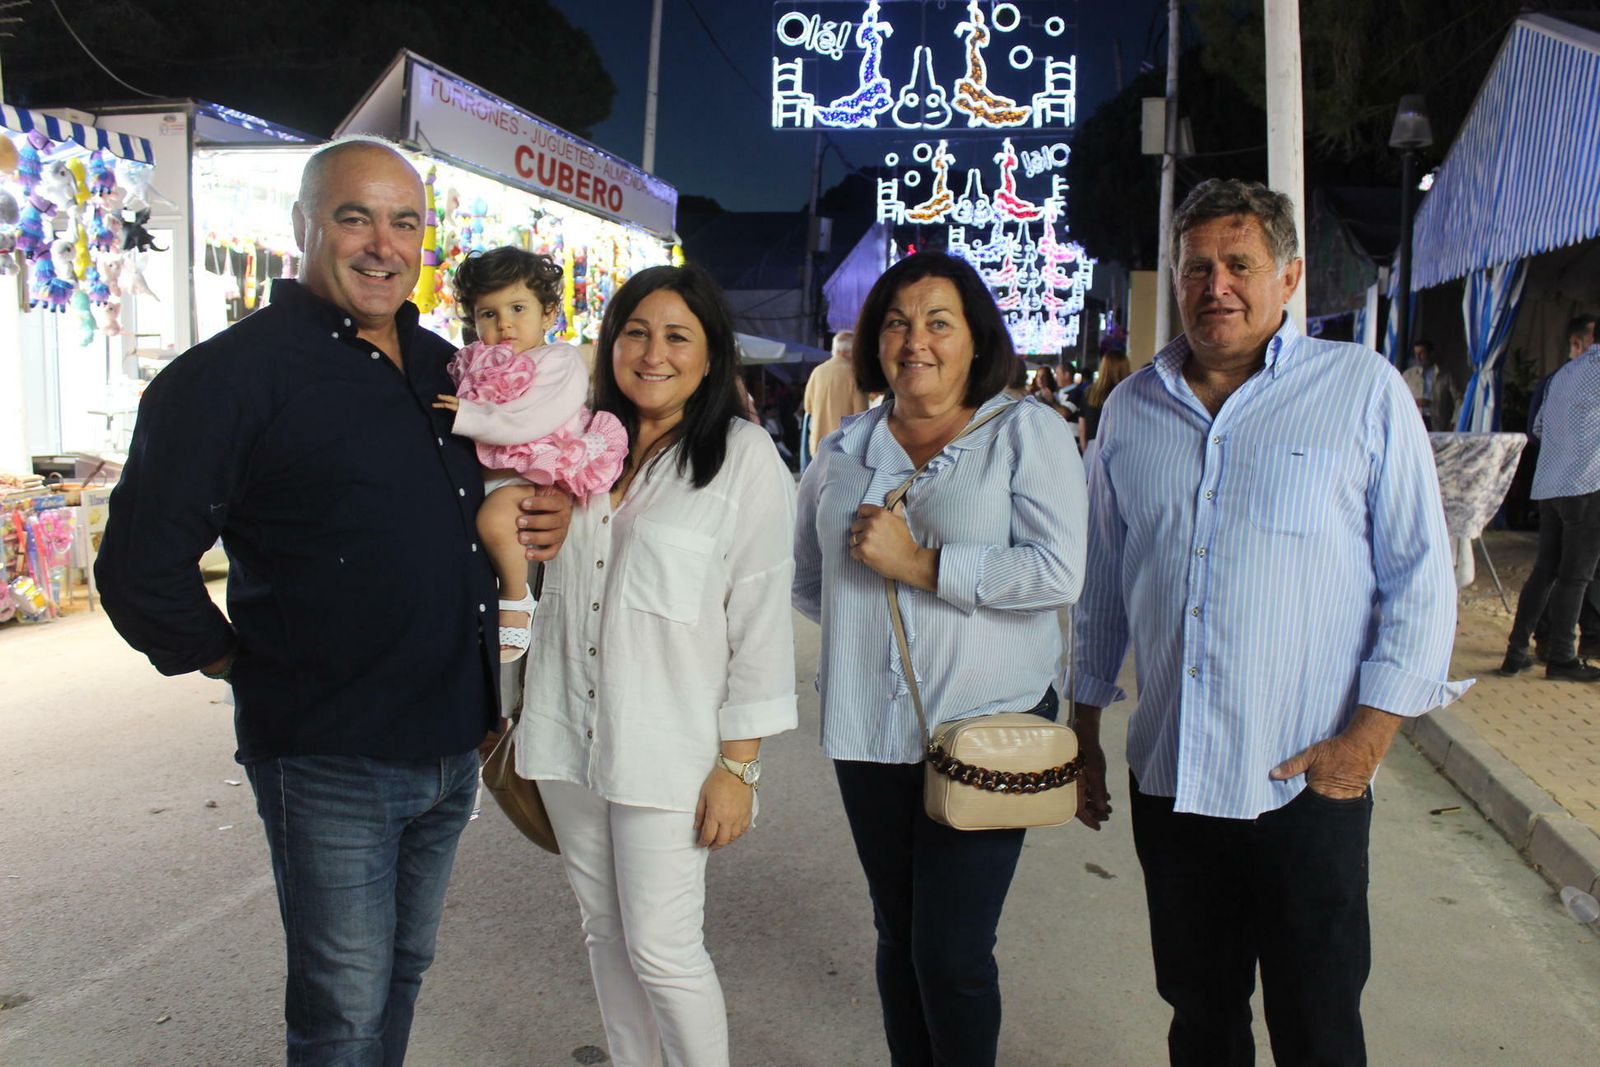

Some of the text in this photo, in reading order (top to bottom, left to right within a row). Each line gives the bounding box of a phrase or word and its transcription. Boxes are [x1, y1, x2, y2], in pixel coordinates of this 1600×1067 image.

[431, 78, 519, 135] TURRONES
[530, 127, 595, 169] JUGUETES
[515, 145, 623, 212] CUBERO
